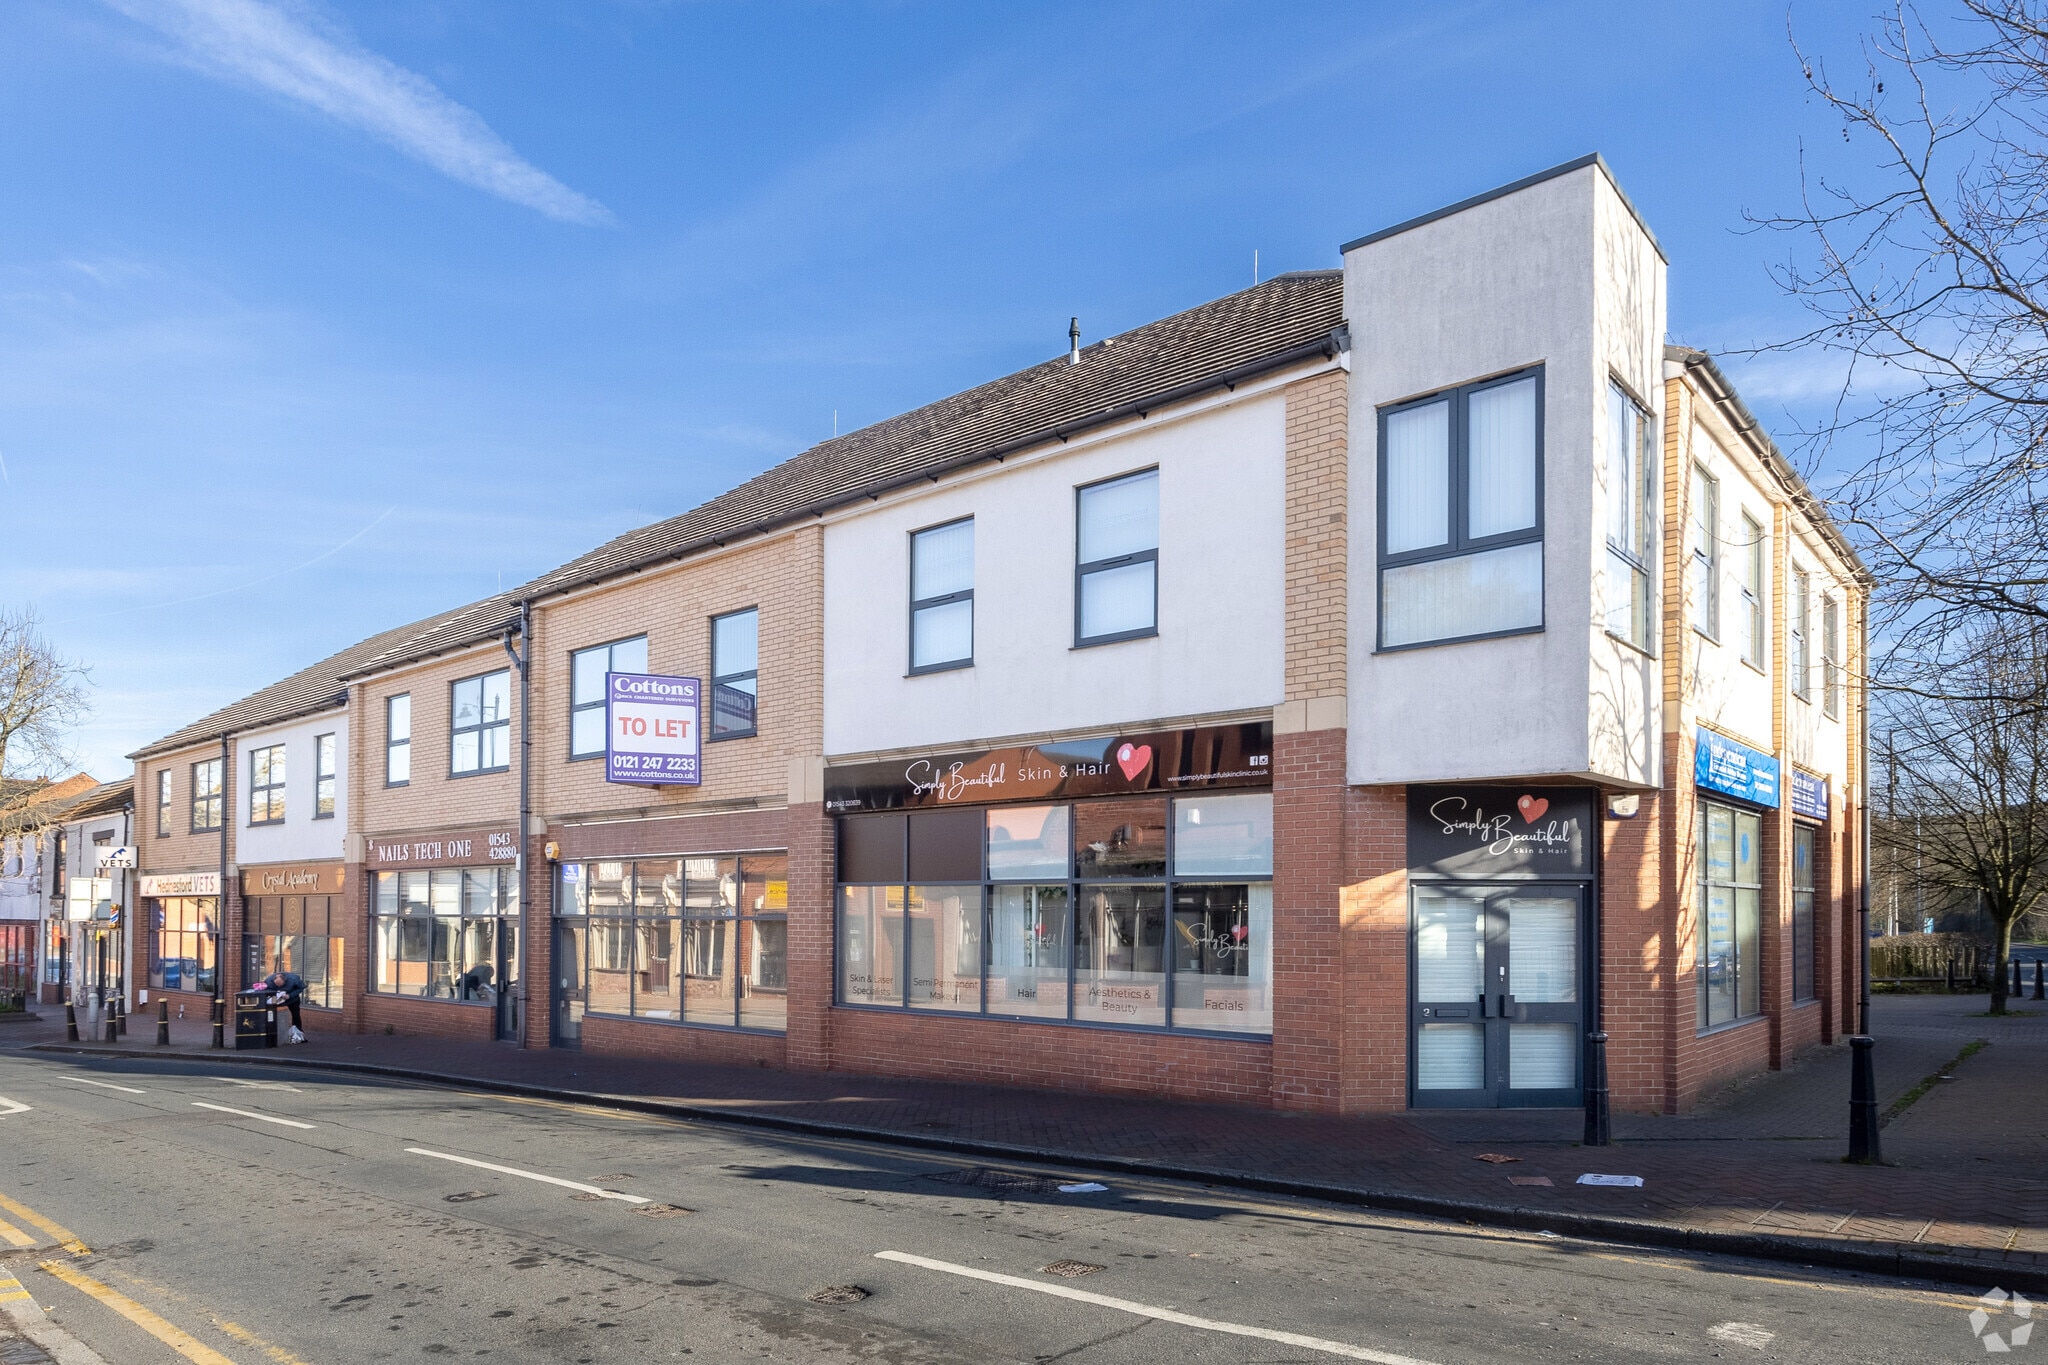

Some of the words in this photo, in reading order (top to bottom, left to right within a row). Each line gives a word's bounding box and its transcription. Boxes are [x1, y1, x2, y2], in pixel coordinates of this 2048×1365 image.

[614, 677, 695, 696] Cottons
[618, 717, 647, 736] TO
[654, 719, 691, 738] LET
[613, 755, 639, 769] 0121
[642, 756, 663, 769] 247
[667, 758, 696, 771] 2233
[613, 770, 696, 779] www.cottons.co.uk
[905, 760, 947, 799] Simply
[947, 761, 1006, 800] Beautiful
[1018, 767, 1051, 782] Skin
[1059, 765, 1068, 777] &
[1076, 762, 1111, 776] Hair
[1167, 769, 1269, 782] www.simplybeautifulskinclinic.co.uk
[1430, 796, 1491, 842] Simply
[1488, 814, 1571, 856] Beautiful
[488, 832, 511, 846] 01543
[379, 844, 409, 862] NAILS
[414, 842, 442, 860] TECH
[448, 840, 472, 858] ONE
[488, 846, 517, 860] 428880
[194, 876, 215, 892] VETS
[262, 870, 287, 892] Crystal
[286, 869, 319, 891] Academy
[850, 974, 866, 983] Skin
[867, 974, 872, 983] &
[913, 977, 933, 987] Semi
[1017, 988, 1036, 999] Hair
[1088, 986, 1141, 999] Aesthetics
[1144, 989, 1151, 999] &
[1102, 1001, 1138, 1015] Beauty
[1204, 999, 1244, 1011] Facials
[1423, 1008, 1430, 1017] 2
